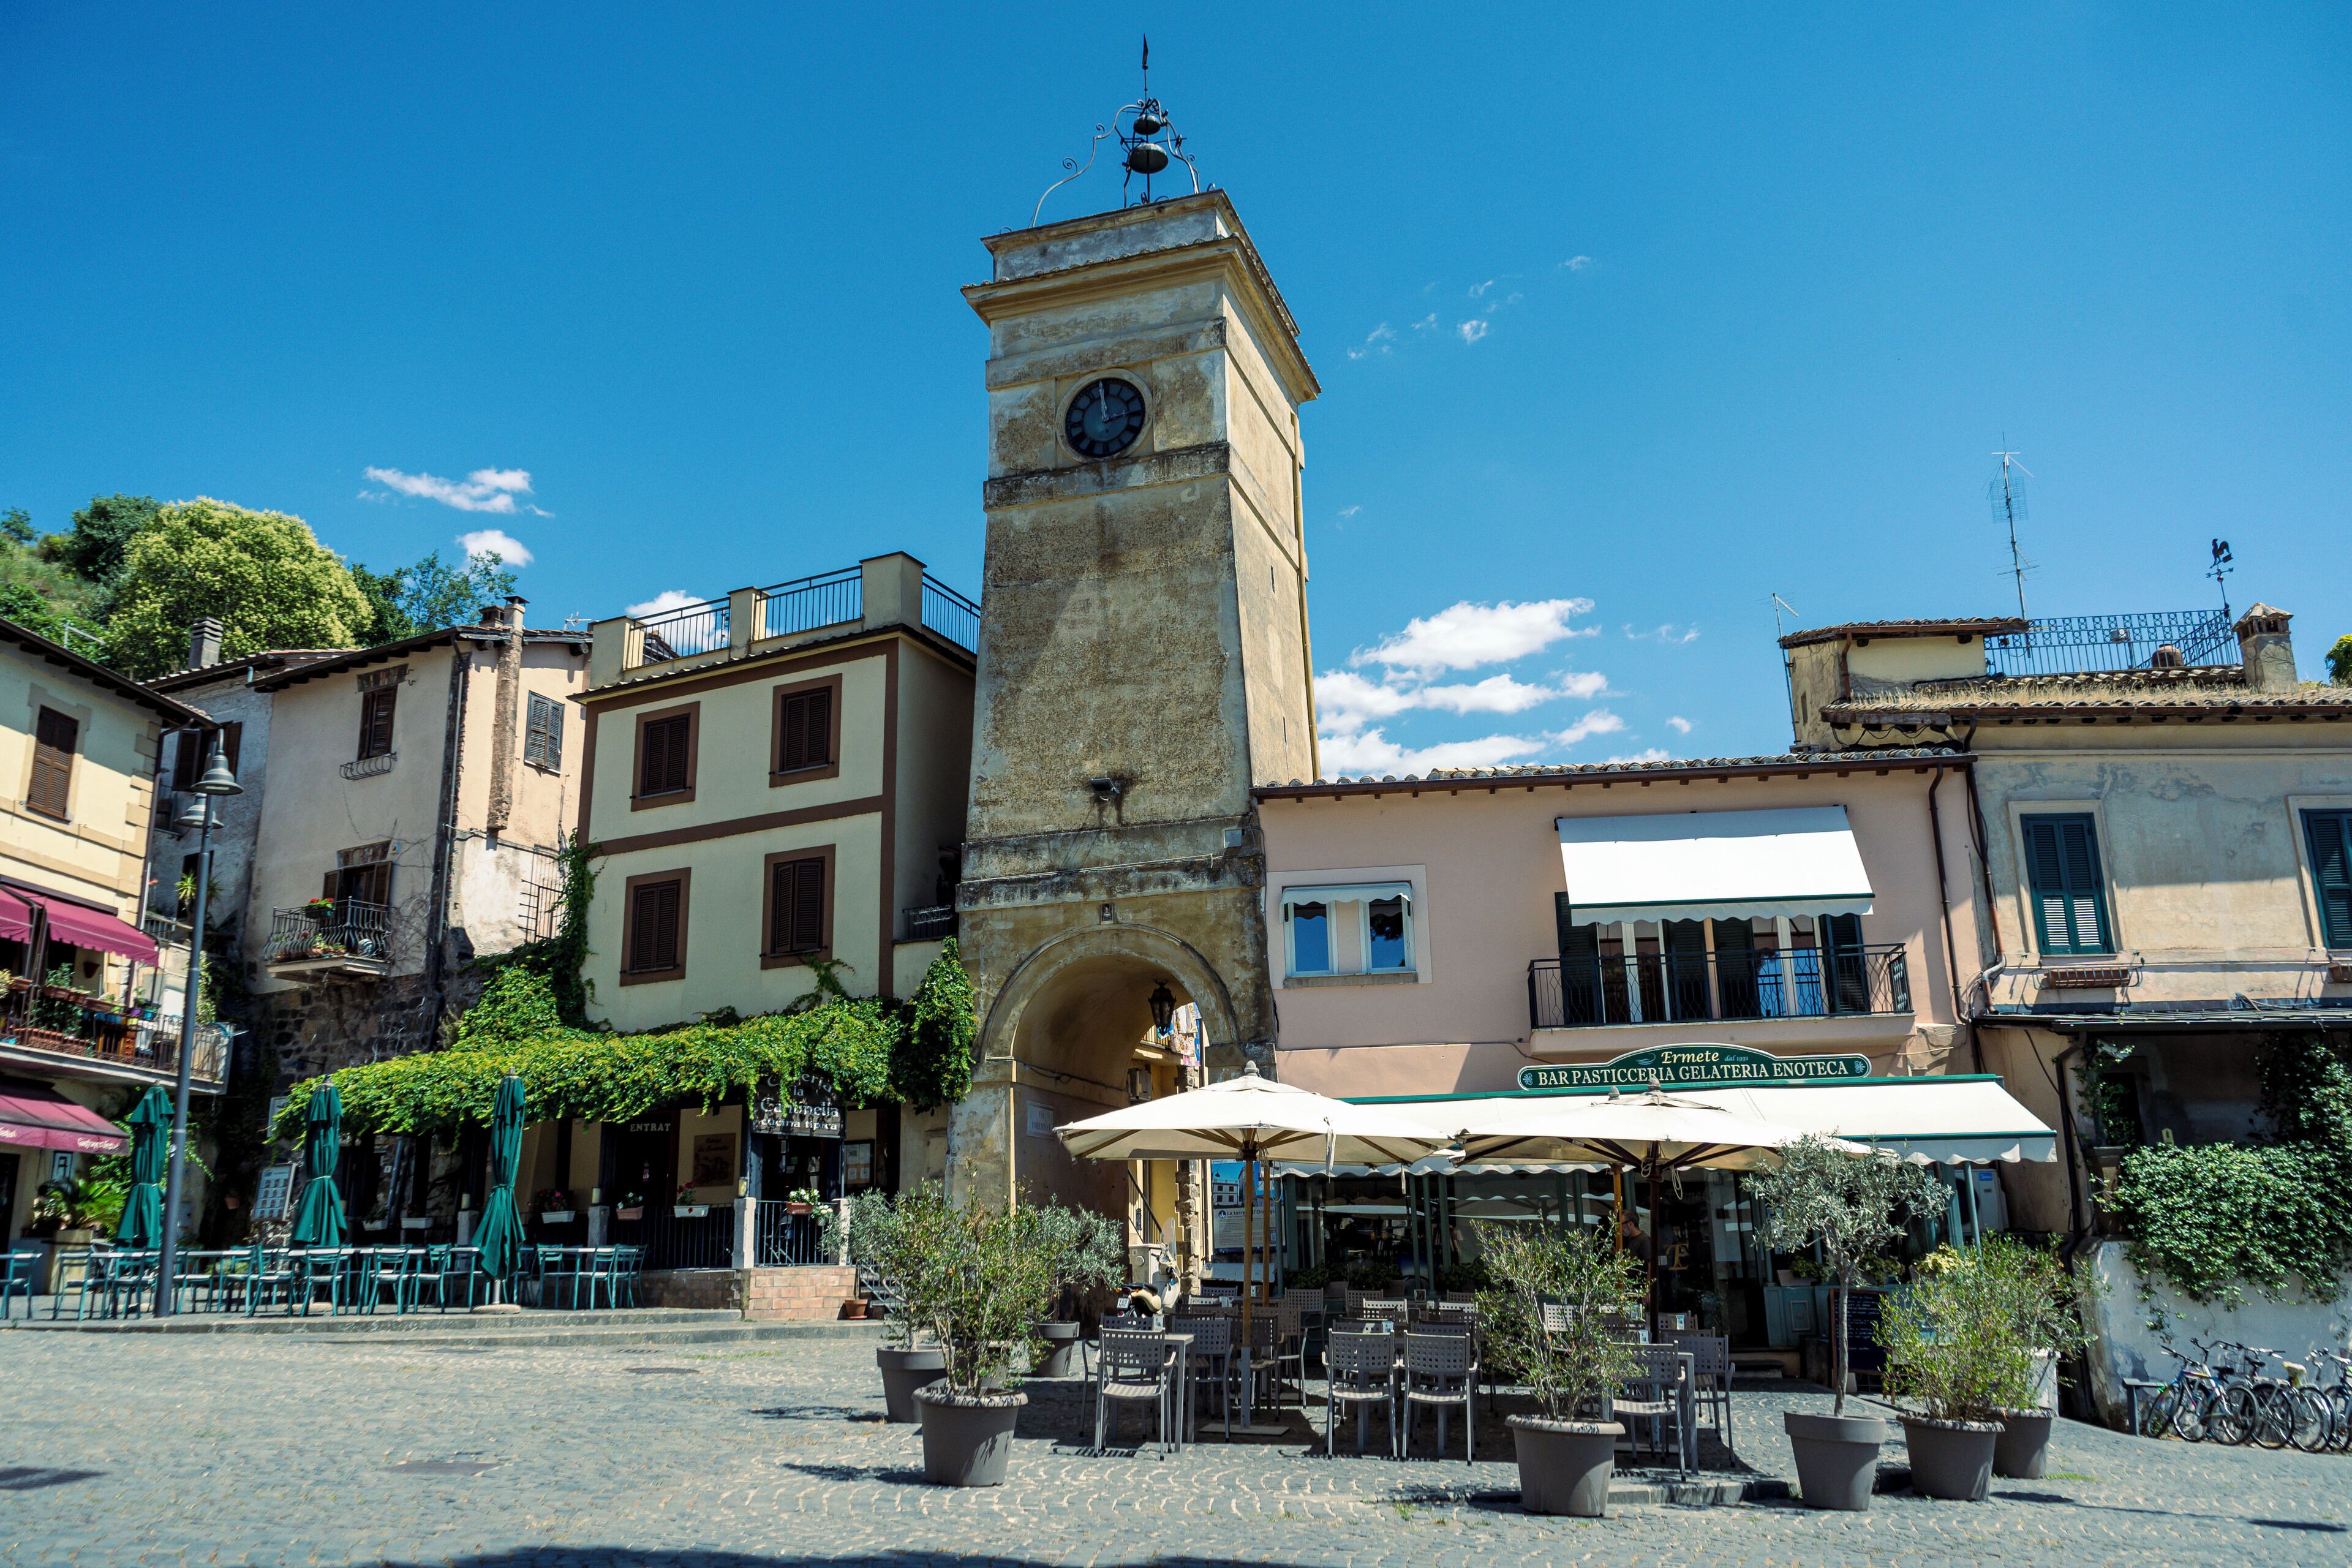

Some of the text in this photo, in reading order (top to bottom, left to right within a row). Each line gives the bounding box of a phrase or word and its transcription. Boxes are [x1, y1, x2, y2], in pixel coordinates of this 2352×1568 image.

[1660, 1050, 1720, 1064] Ermete
[1537, 1061, 1849, 1085] BAR PASTICCERIA GELATERIA ENOTECA
[767, 1073, 833, 1093] Oeria
[793, 1085, 804, 1096] la
[630, 1123, 671, 1132] ENTRAT
[761, 1118, 838, 1131] cucina tipica
